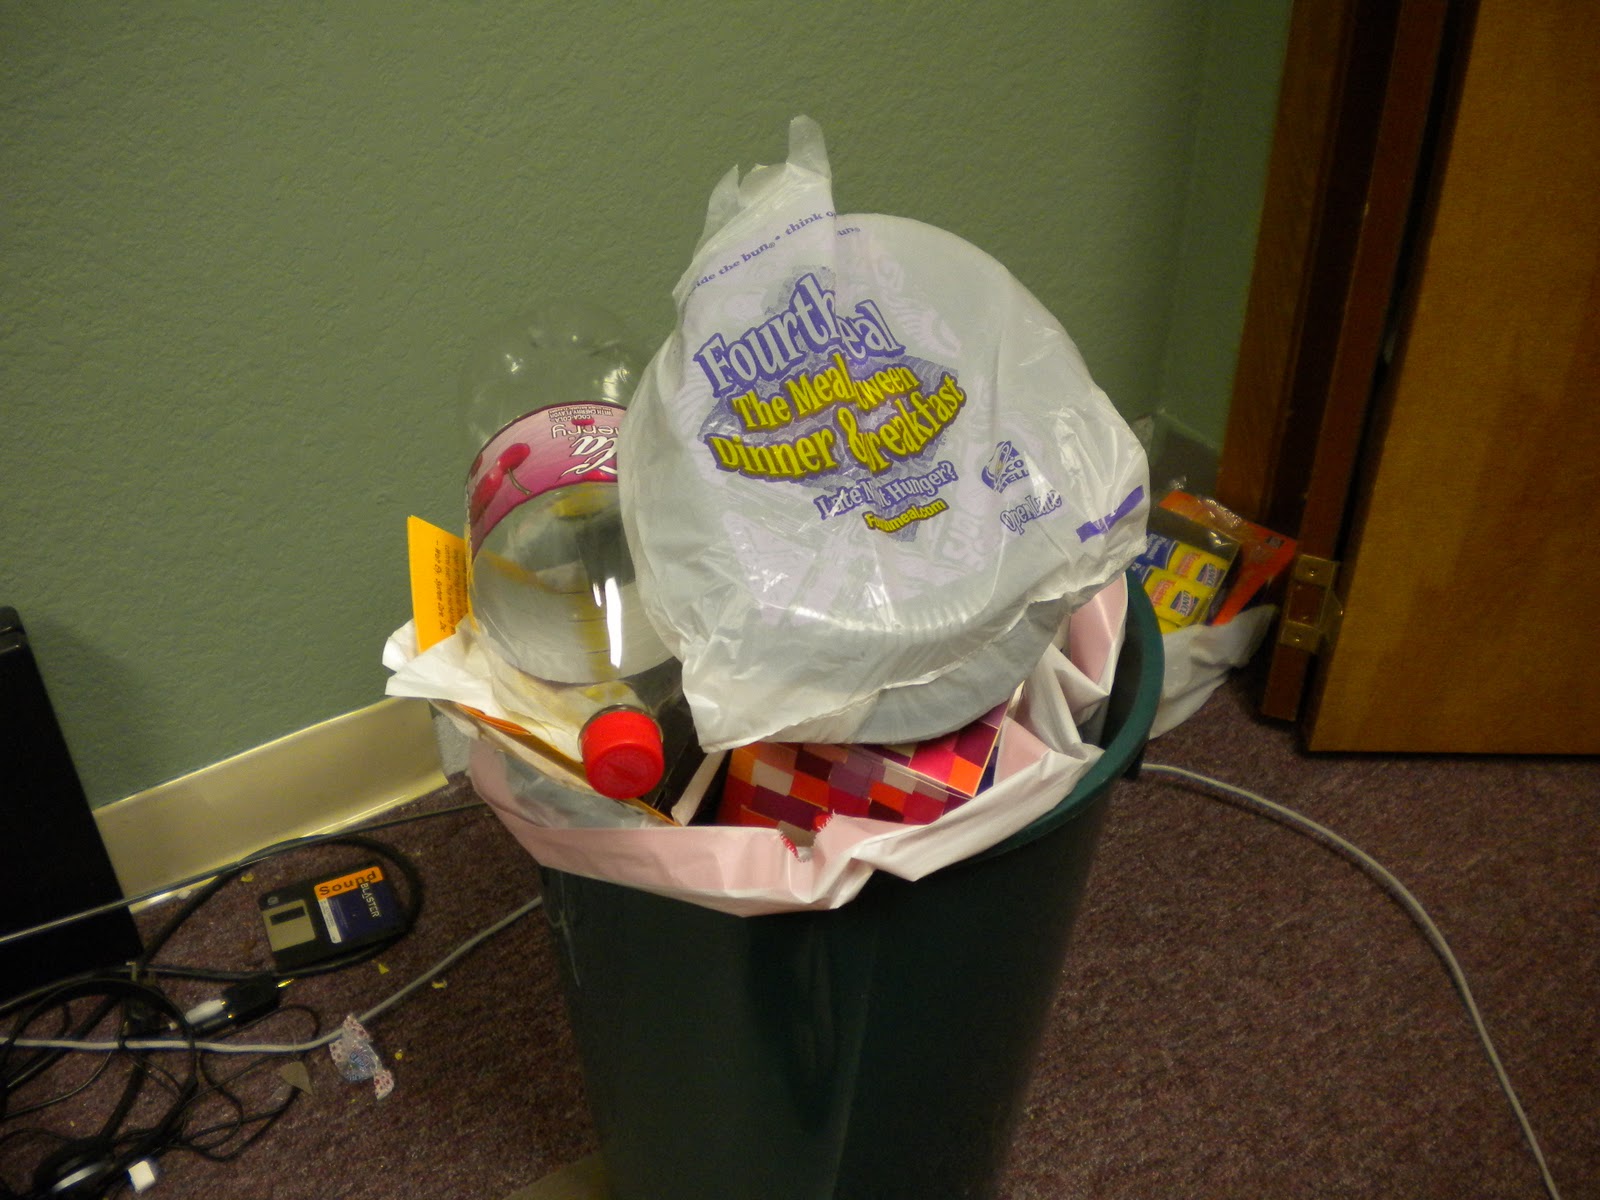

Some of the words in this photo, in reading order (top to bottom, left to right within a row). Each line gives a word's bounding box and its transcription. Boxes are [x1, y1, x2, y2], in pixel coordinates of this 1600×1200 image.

[719, 261, 740, 275] the
[785, 213, 824, 236] think
[729, 389, 794, 431] The
[781, 350, 855, 418] Meal
[705, 424, 842, 480] Dinner
[862, 370, 967, 476] reakfast
[883, 461, 958, 502] Hunger?
[318, 870, 377, 896] Sound
[360, 882, 381, 918] BLASTER
